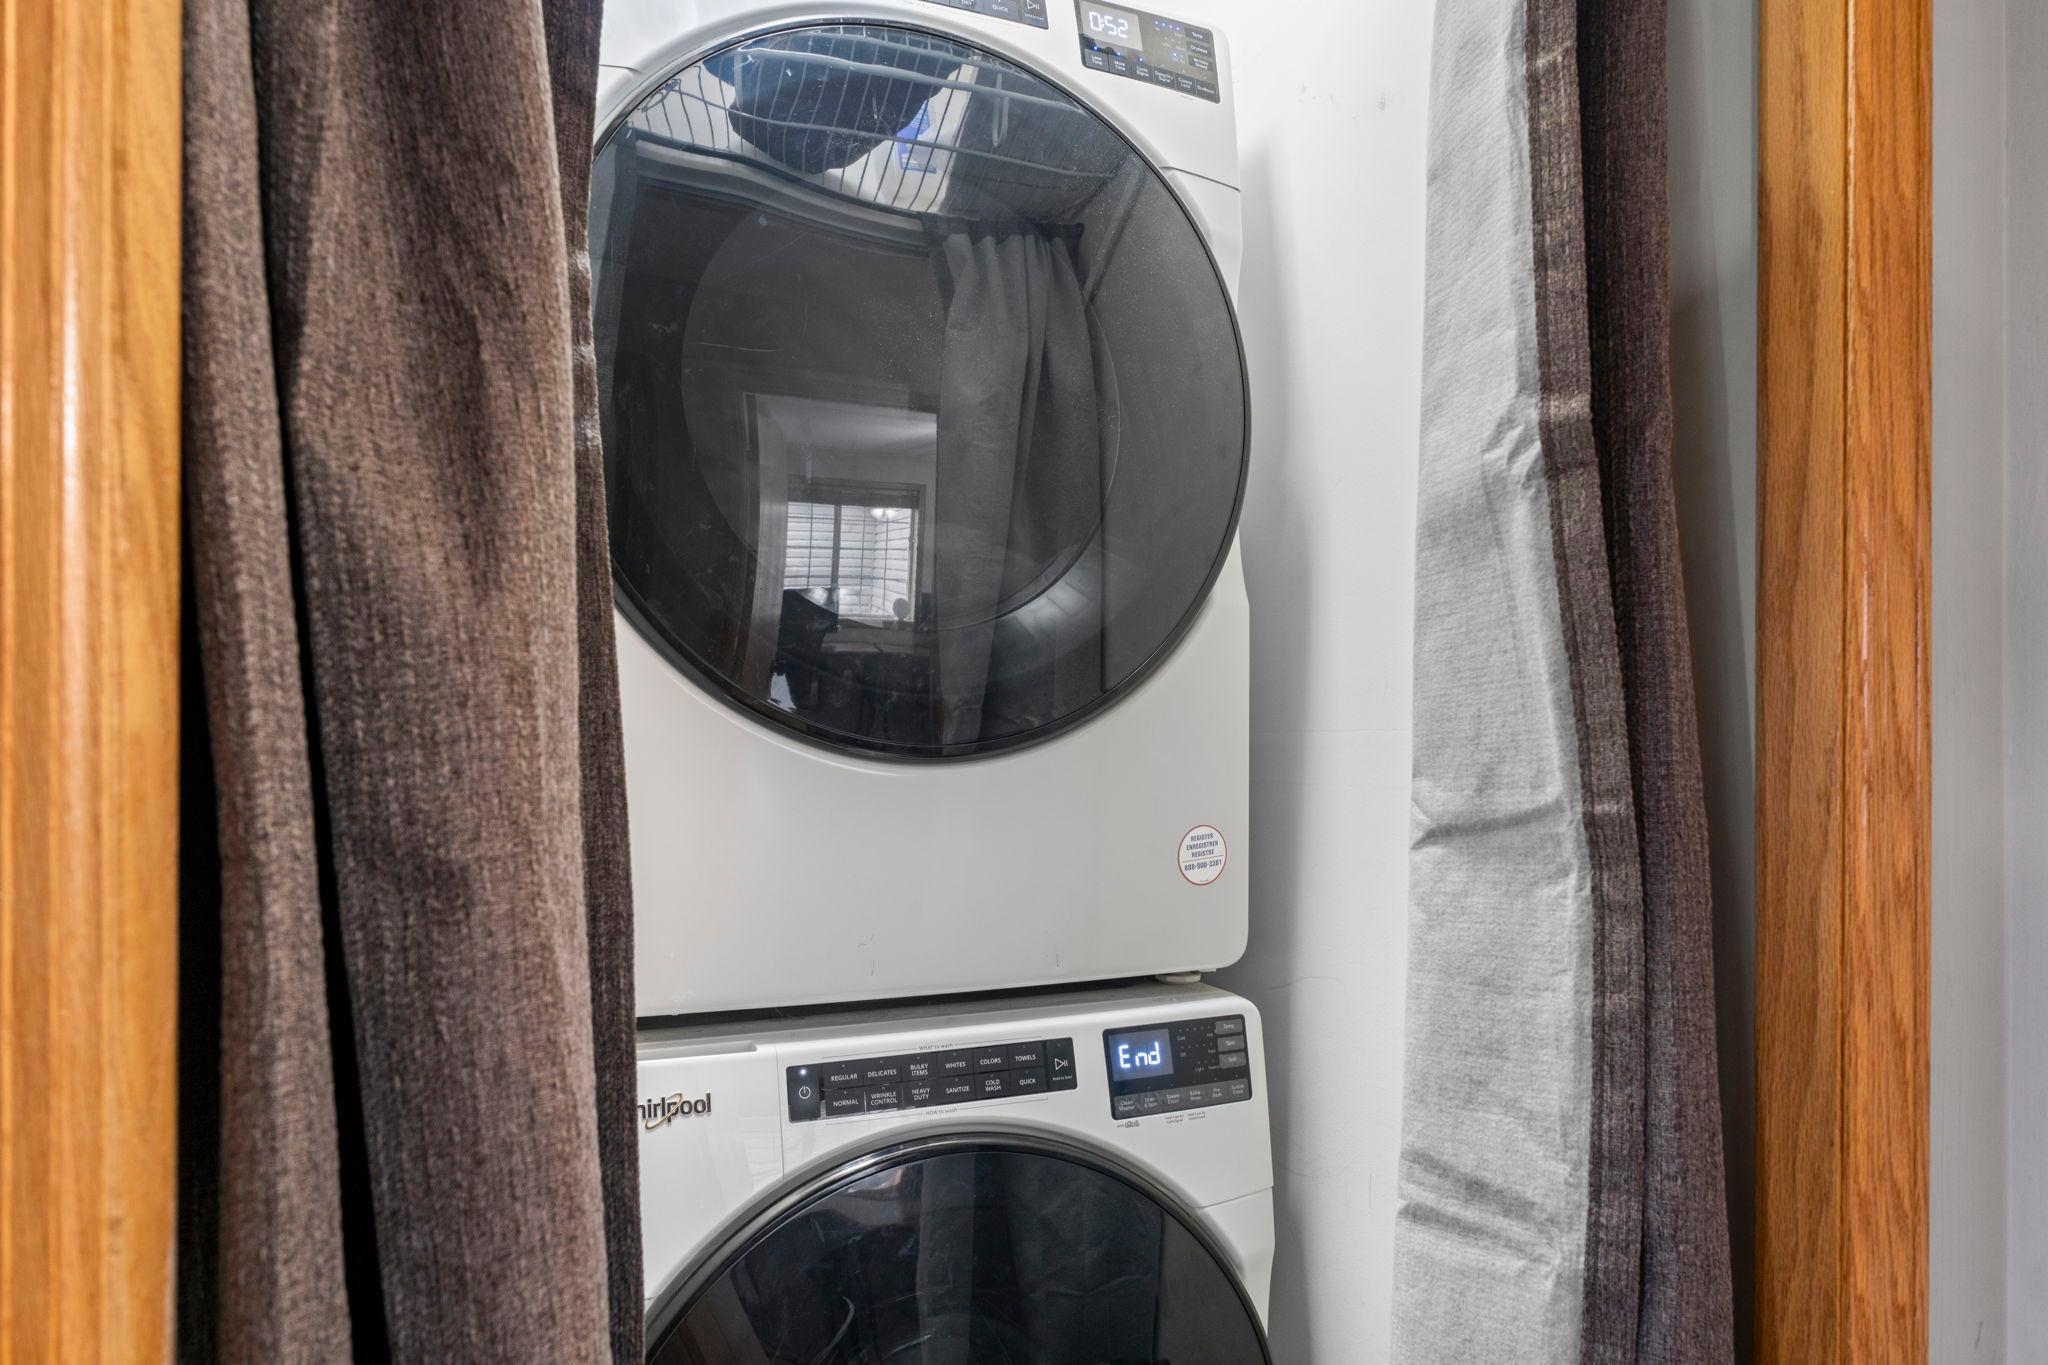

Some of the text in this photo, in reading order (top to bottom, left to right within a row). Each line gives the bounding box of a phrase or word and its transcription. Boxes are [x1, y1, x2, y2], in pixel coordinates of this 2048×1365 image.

[992, 4, 1009, 13] QUICK
[1088, 11, 1129, 38] 0:52
[1190, 833, 1214, 842] REGISTER
[1186, 840, 1219, 851] ENREGISTRER
[1014, 1054, 1036, 1062] TOWELS
[1118, 1041, 1161, 1068] End
[944, 1061, 966, 1069] WHITES
[979, 1057, 1002, 1065] COLORS
[910, 1063, 929, 1071] BULKY
[830, 1073, 858, 1081] REGULAR
[867, 1069, 897, 1078] DELICATES
[1019, 1078, 1036, 1086] QUICK
[945, 1086, 970, 1094] SANITIZE
[984, 1084, 1002, 1092] WASH
[870, 1091, 897, 1100] WRINKLE
[833, 1099, 859, 1107] NORMAL
[870, 1097, 898, 1106] CONTROL
[637, 1093, 712, 1123] irlpool
